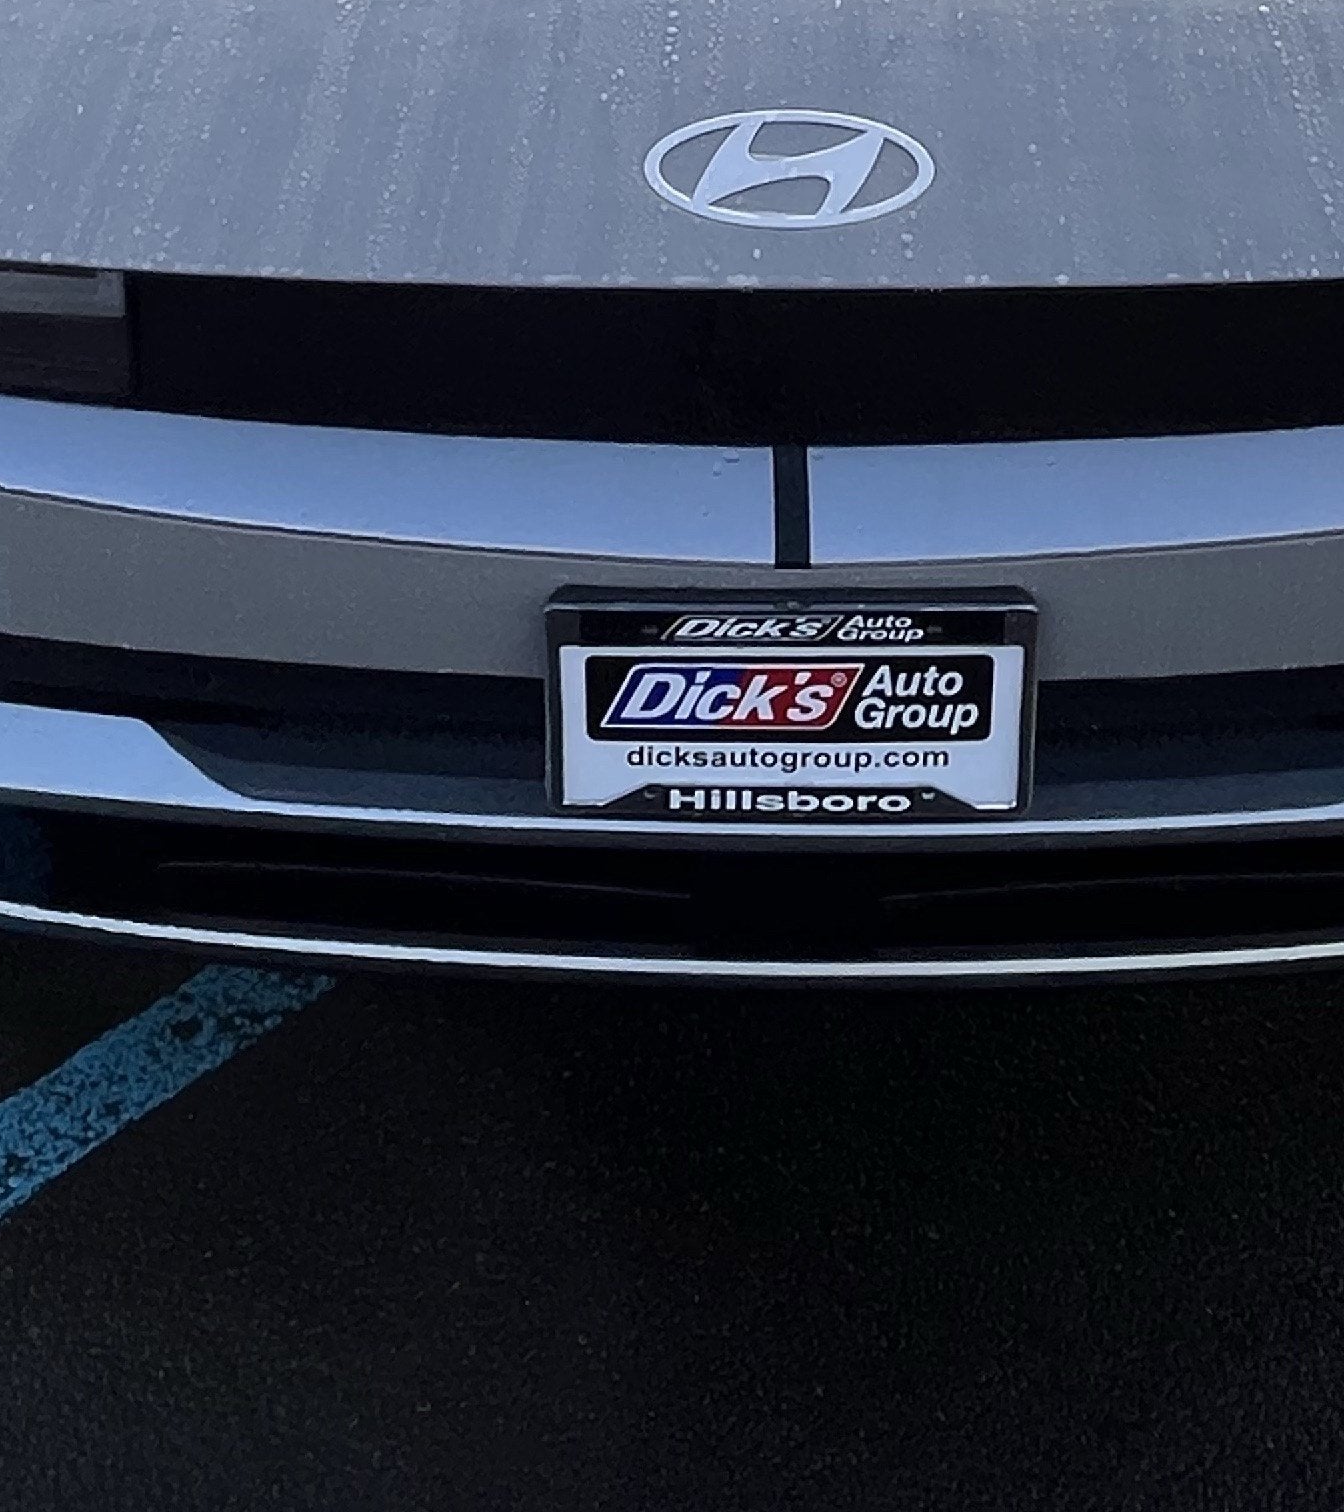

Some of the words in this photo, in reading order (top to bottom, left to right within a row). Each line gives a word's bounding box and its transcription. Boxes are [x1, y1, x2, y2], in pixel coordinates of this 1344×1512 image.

[674, 616, 824, 639] Dick's
[847, 614, 913, 628] Auto
[837, 627, 925, 642] Group
[861, 664, 964, 697] Auto
[619, 669, 836, 723] Dick's
[854, 698, 980, 736] Group
[626, 746, 949, 773] dicksautogroup.com
[668, 789, 912, 813] Hillsboro
